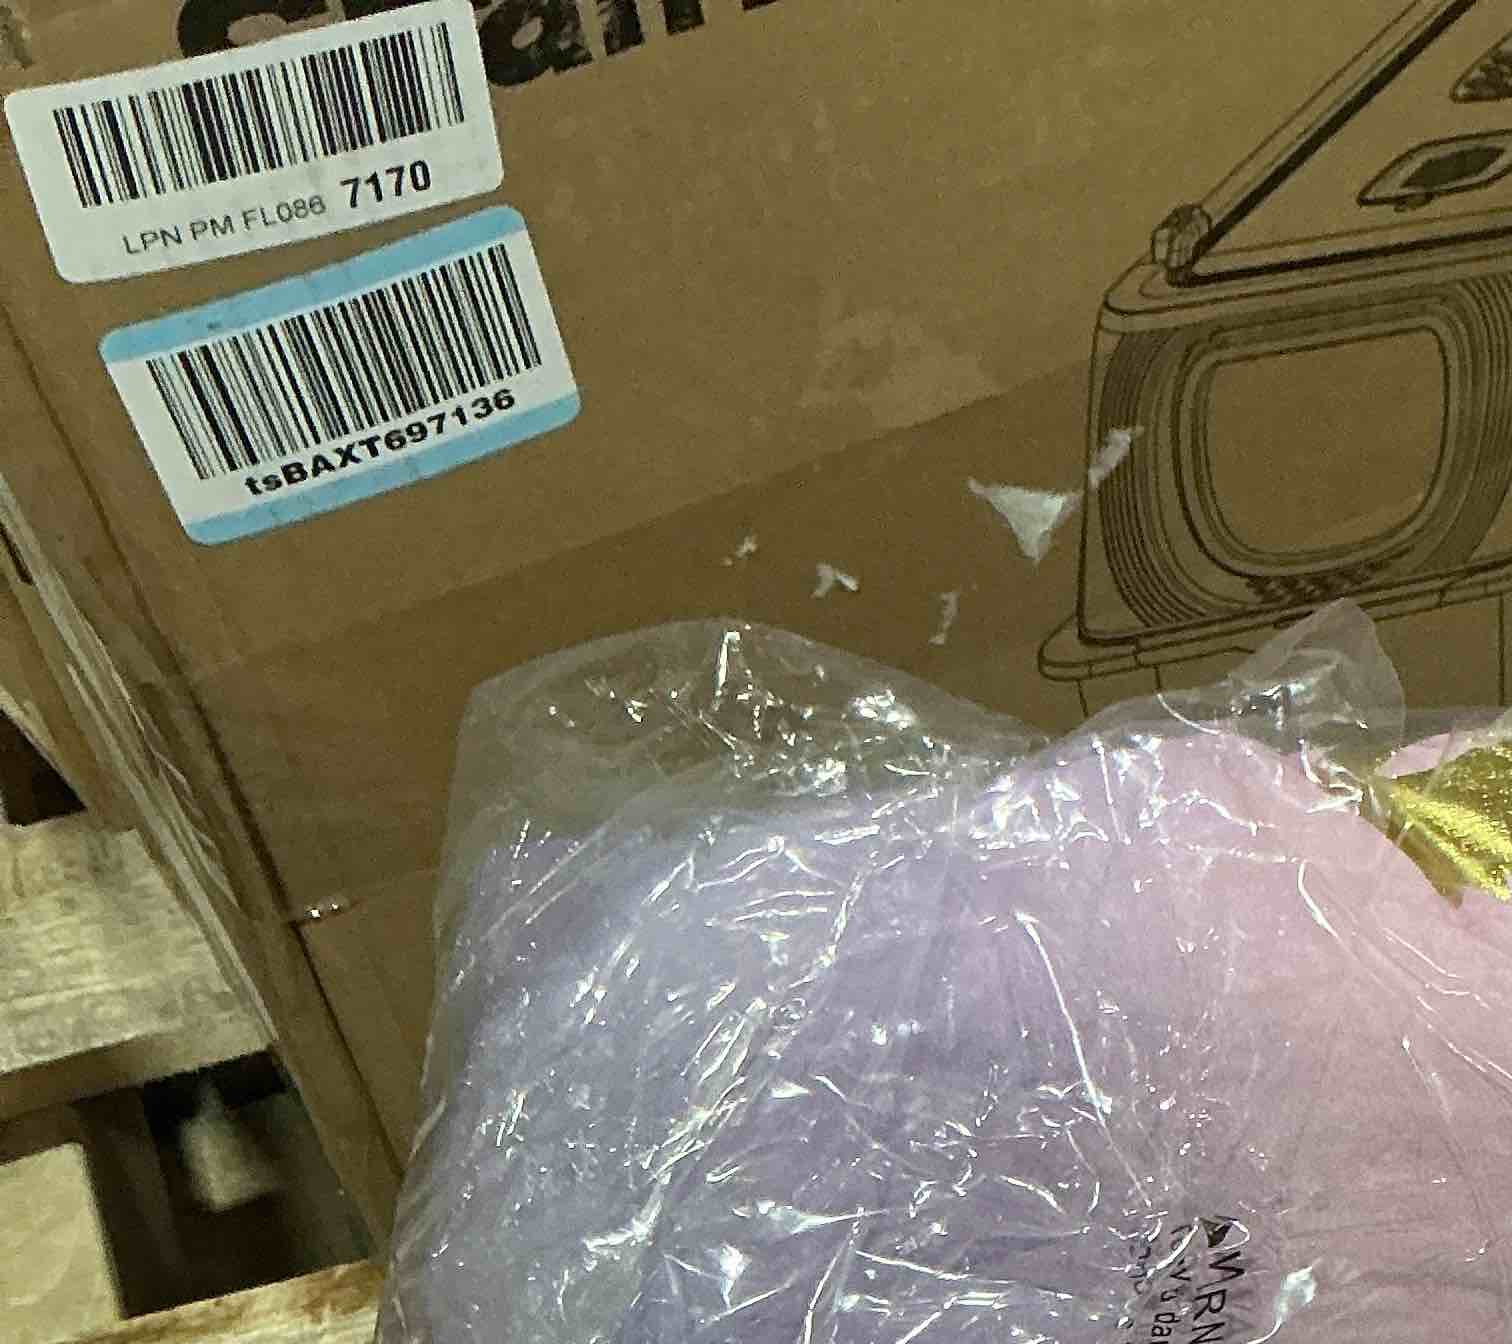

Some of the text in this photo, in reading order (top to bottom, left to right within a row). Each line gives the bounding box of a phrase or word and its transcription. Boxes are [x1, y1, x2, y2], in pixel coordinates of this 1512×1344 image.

[121, 223, 183, 255] LPN
[190, 215, 235, 241] PM
[340, 160, 432, 209] 7170
[244, 388, 516, 496] tsBAXT697136
